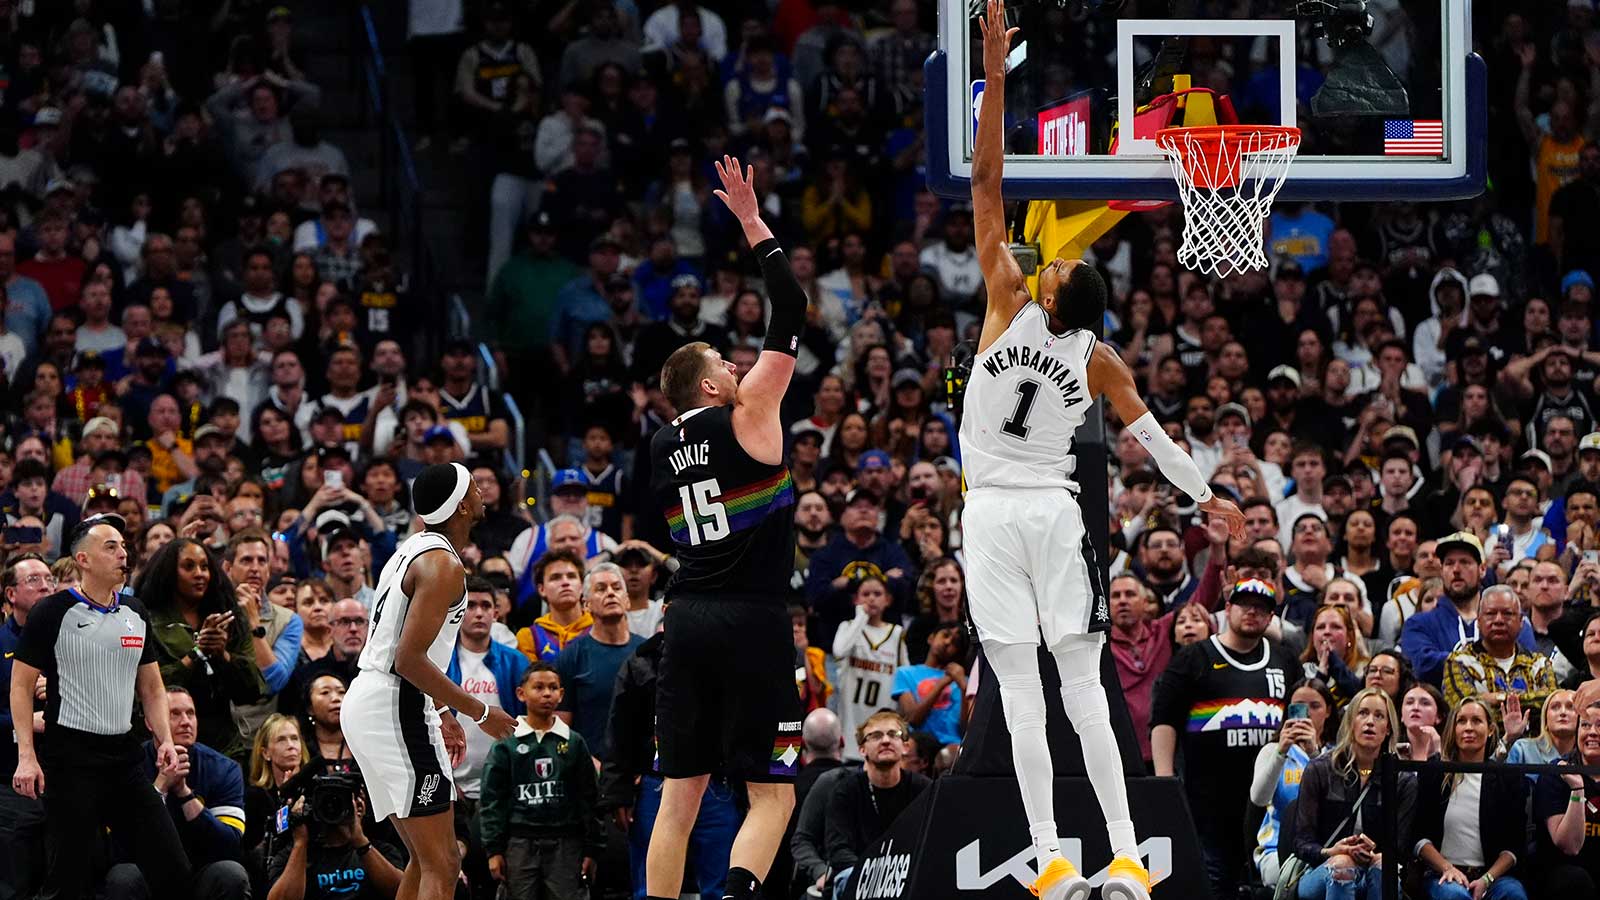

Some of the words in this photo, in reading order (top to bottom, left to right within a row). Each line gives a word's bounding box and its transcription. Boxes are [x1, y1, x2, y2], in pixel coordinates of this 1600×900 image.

[982, 345, 1084, 409] WEMBANYAMA
[999, 378, 1042, 442] 1
[668, 440, 710, 475] JOKIĆ
[678, 477, 731, 546] 15
[853, 677, 881, 707] 10
[1266, 673, 1286, 699] 15
[855, 838, 911, 900] coinbase
